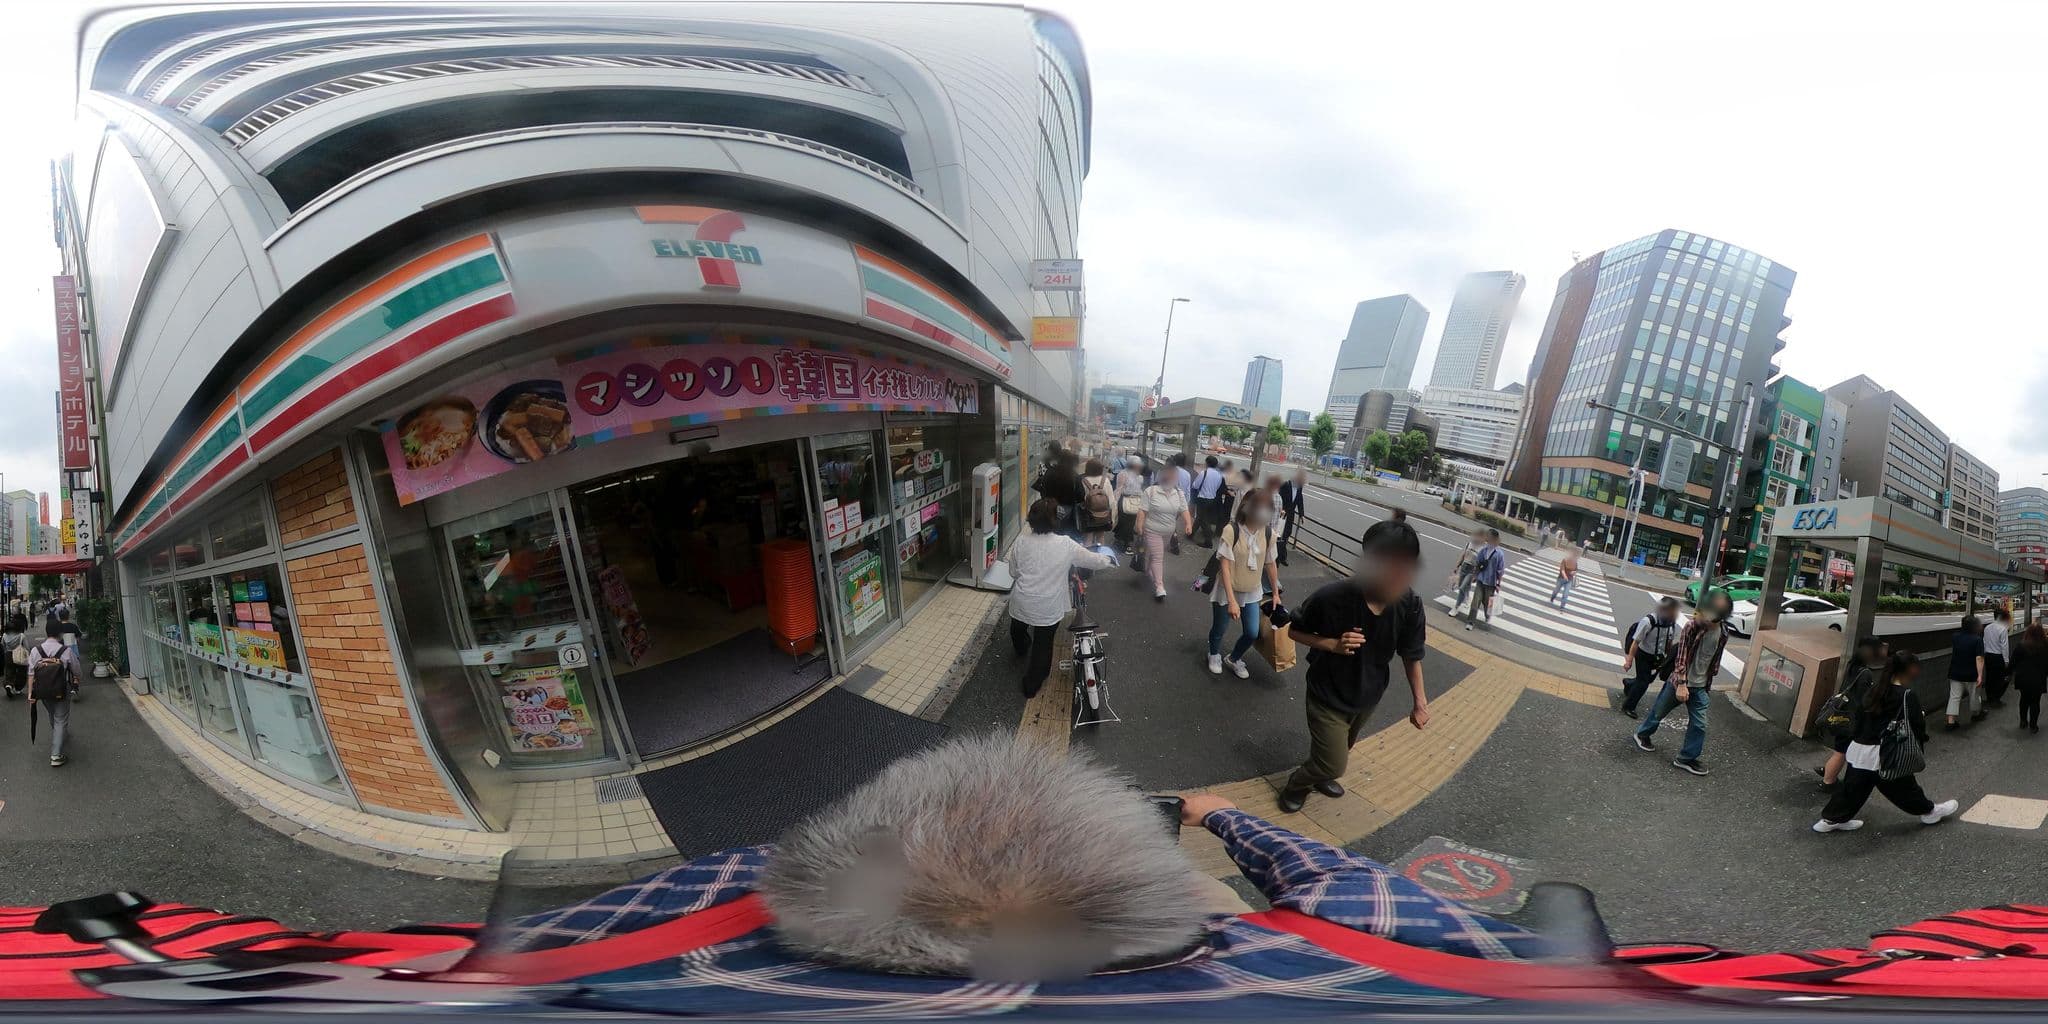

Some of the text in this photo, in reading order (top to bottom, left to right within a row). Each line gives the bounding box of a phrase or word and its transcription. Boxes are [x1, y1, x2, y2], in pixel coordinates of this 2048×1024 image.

[1044, 274, 1072, 285] 24H
[1217, 404, 1251, 421] ESCA
[1792, 507, 1838, 530] ESCA
